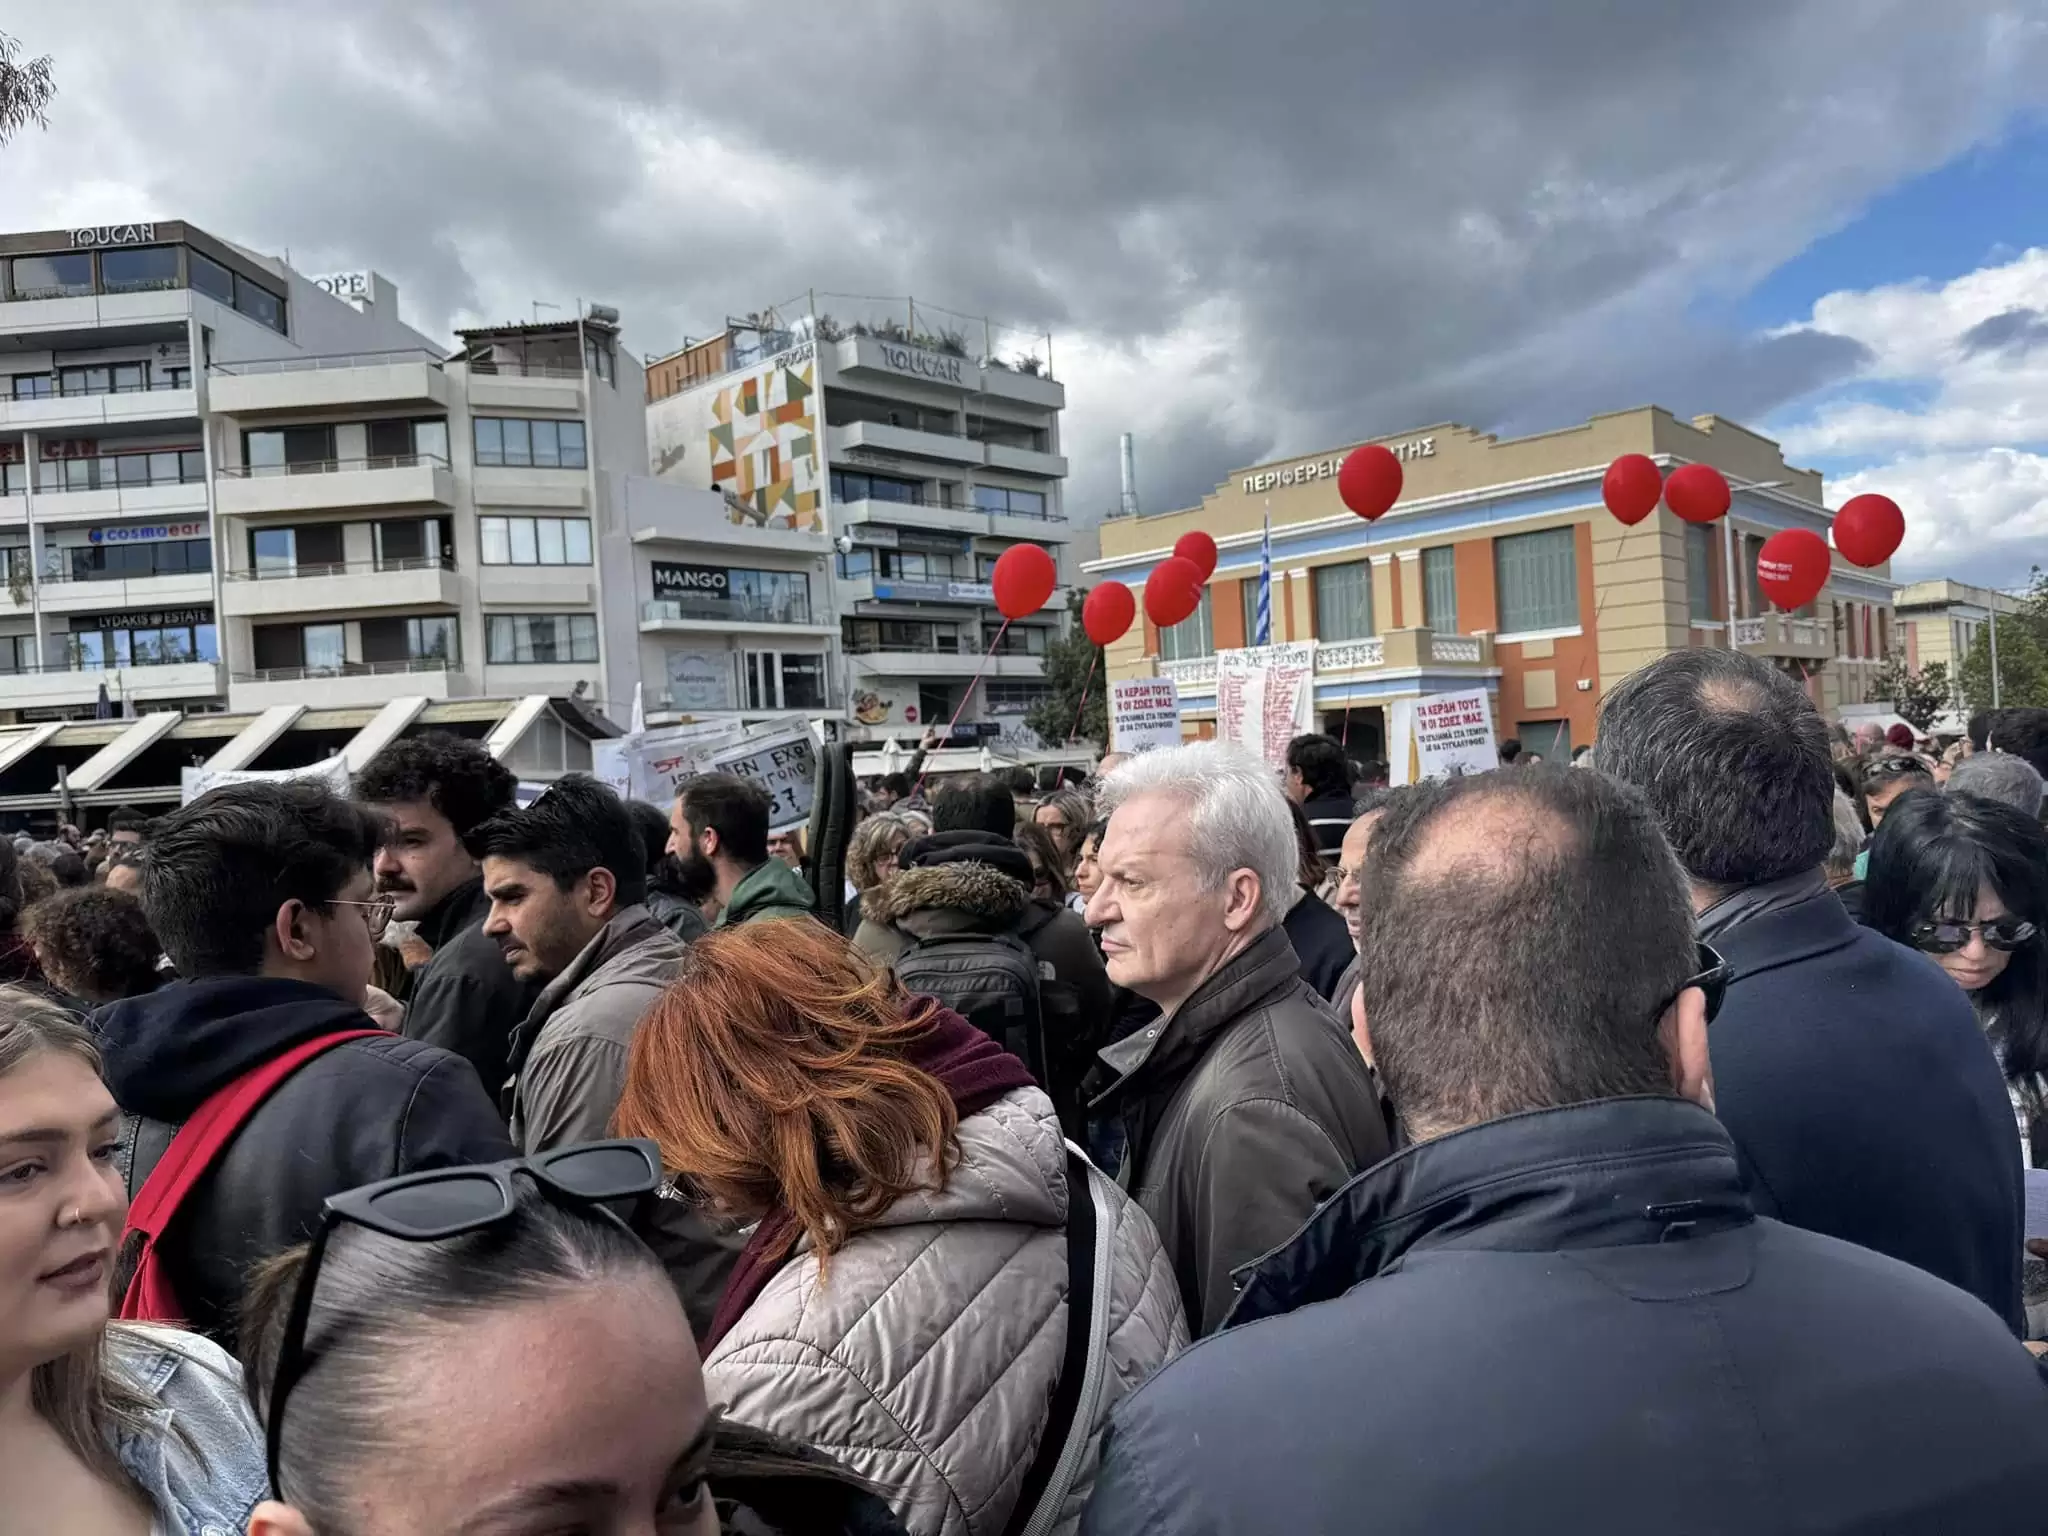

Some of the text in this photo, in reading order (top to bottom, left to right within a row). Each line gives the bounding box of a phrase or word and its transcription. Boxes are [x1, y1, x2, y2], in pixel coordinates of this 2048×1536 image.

[66, 223, 155, 247] TOUCAN
[775, 342, 814, 371] TOUCAN
[880, 344, 962, 384] TOUCAN
[107, 523, 201, 541] cosmoear
[655, 568, 727, 589] MANGO
[164, 607, 208, 625] ESTATE
[1417, 698, 1481, 717] ΤΑ ΚΕΡΔΗ ΤΟΥΣ
[1463, 711, 1484, 725] ΜΑΣ
